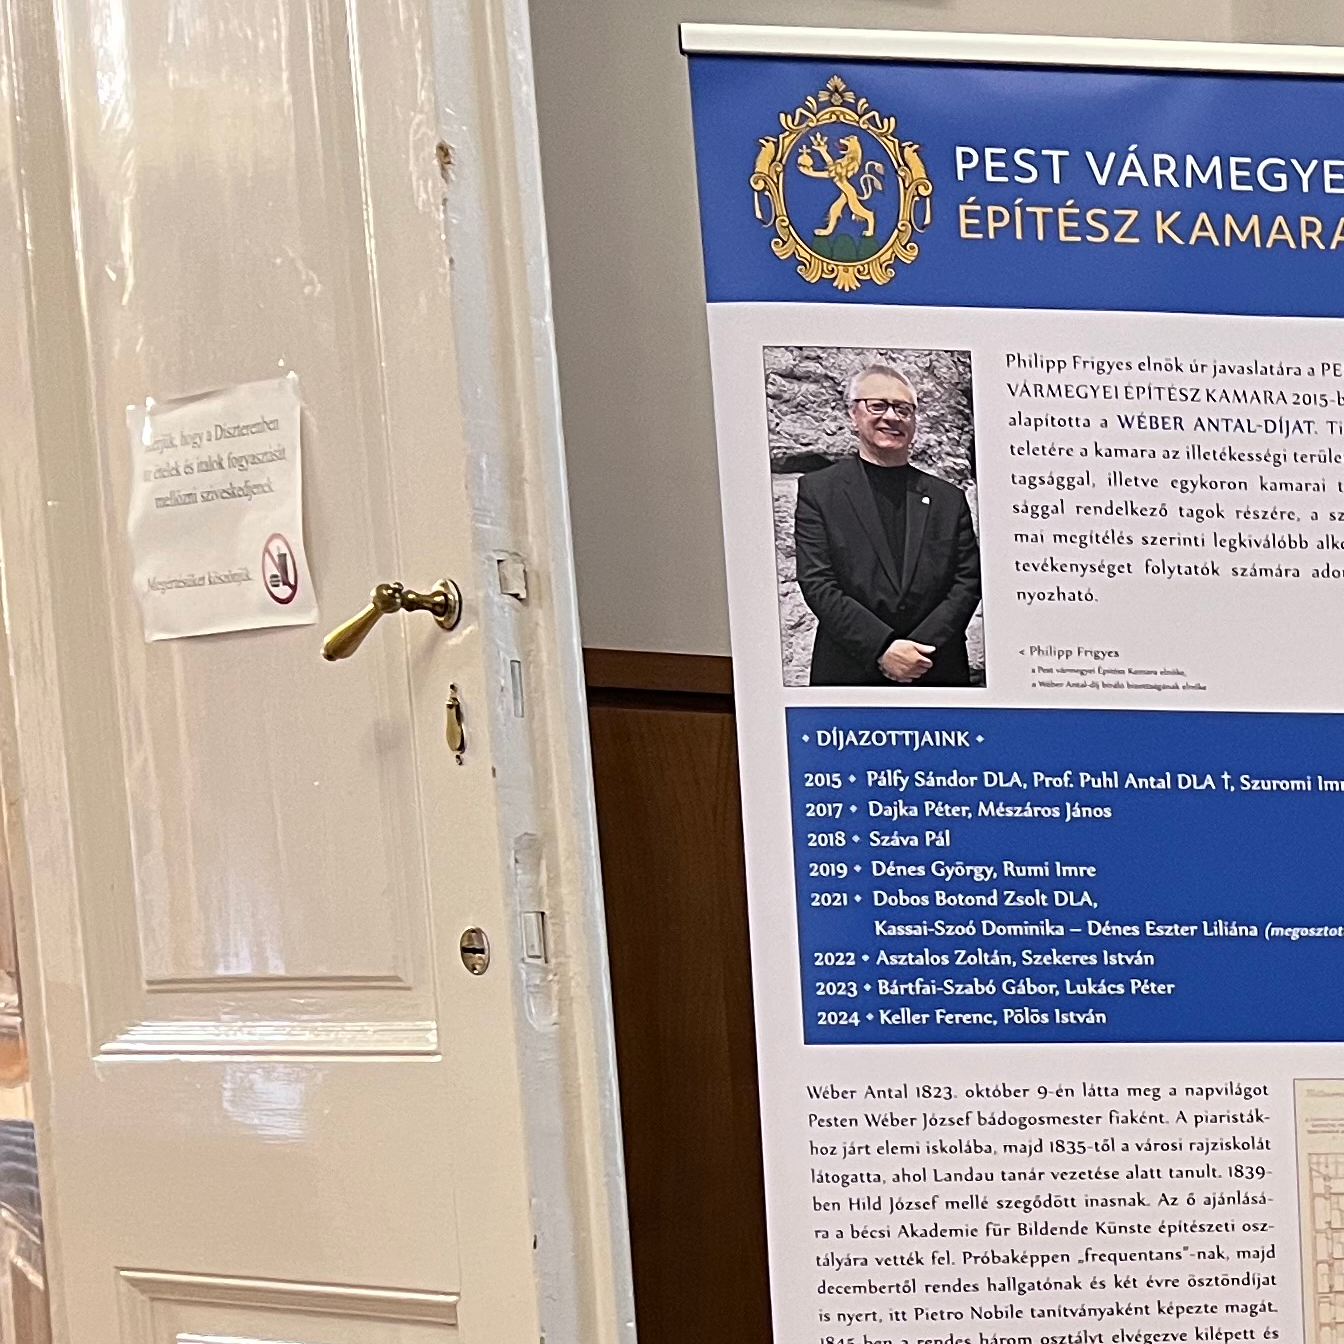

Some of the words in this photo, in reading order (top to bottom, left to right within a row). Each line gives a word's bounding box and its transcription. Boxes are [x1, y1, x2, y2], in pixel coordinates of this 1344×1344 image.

[954, 144, 1070, 185] PEST
[958, 195, 1140, 244] ÉPÍTÉSZ
[1005, 351, 1068, 374] Philipp
[1071, 354, 1133, 376] Frigyes
[1136, 354, 1184, 374] elnök
[1188, 358, 1208, 374] úr
[1211, 358, 1302, 379] javaslatára
[1306, 366, 1316, 377] a
[1005, 380, 1119, 400] VÁRMEGYEI
[1123, 382, 1201, 403] ÉPÍTÉSZ
[1204, 387, 1288, 405] KAMARA
[1028, 643, 1074, 661] Philipp
[1076, 645, 1120, 661] Frigyes
[815, 725, 971, 752] DÍJAZOTTJAINK
[803, 772, 843, 790] 2015
[865, 767, 910, 792] Pálfy
[913, 768, 979, 788] Sándor
[981, 770, 1028, 790] DLA,
[1031, 769, 1075, 789] Prof.
[1077, 769, 1119, 789] Puhl
[1123, 770, 1172, 790] Antal
[1176, 772, 1216, 791] DLA
[1238, 773, 1312, 792] Szuromi
[804, 801, 844, 819] 2017
[866, 798, 919, 822] Dajka
[922, 799, 973, 820] Péter,
[976, 800, 1061, 818] Mészáros
[1064, 800, 1113, 823] János
[806, 829, 847, 847] 2018
[868, 829, 919, 847] Száva
[924, 828, 951, 847] Pál
[808, 861, 848, 879] 2019
[870, 859, 926, 877] Dénes
[930, 859, 998, 882] György,
[1001, 859, 1050, 877] Rumi
[1054, 860, 1097, 878] Imre
[809, 891, 848, 907] 2021
[871, 887, 930, 907] Dobos
[933, 887, 998, 907] Botond
[1002, 887, 1049, 907] Zsolt
[1052, 889, 1098, 910] DLA,
[873, 918, 977, 937] Kassai-Szoó
[980, 917, 1065, 936] Dominika
[1085, 919, 1141, 937] Dénes
[1144, 919, 1199, 937] Eszter
[1201, 918, 1259, 937] Liliána
[812, 951, 856, 966] 2022
[874, 946, 950, 966] Asztalos
[953, 946, 1017, 968] Zoltán,
[1020, 947, 1098, 966] Szekeres
[1101, 948, 1155, 966] István
[814, 980, 858, 998] 2023
[876, 976, 997, 996] Bártfai-Szabó
[1000, 976, 1060, 997] Gábor,
[1064, 976, 1126, 995] Lukács
[1129, 977, 1176, 995] Péter
[816, 1010, 861, 1027] 2024
[877, 1006, 931, 1025] Keller
[933, 1007, 998, 1026] Ferenc,
[1001, 1005, 1050, 1025] Pölös
[1053, 1007, 1107, 1024] István
[805, 1082, 858, 1100] Wéber
[863, 1082, 908, 1100] Antal
[915, 1083, 958, 1101] 1823.
[964, 1081, 1031, 1099] október
[1036, 1084, 1075, 1100] 9-én
[1081, 1080, 1120, 1098] látta
[1126, 1086, 1162, 1102] meg
[1167, 1086, 1177, 1097] a
[1184, 1079, 1269, 1101] napvilágot
